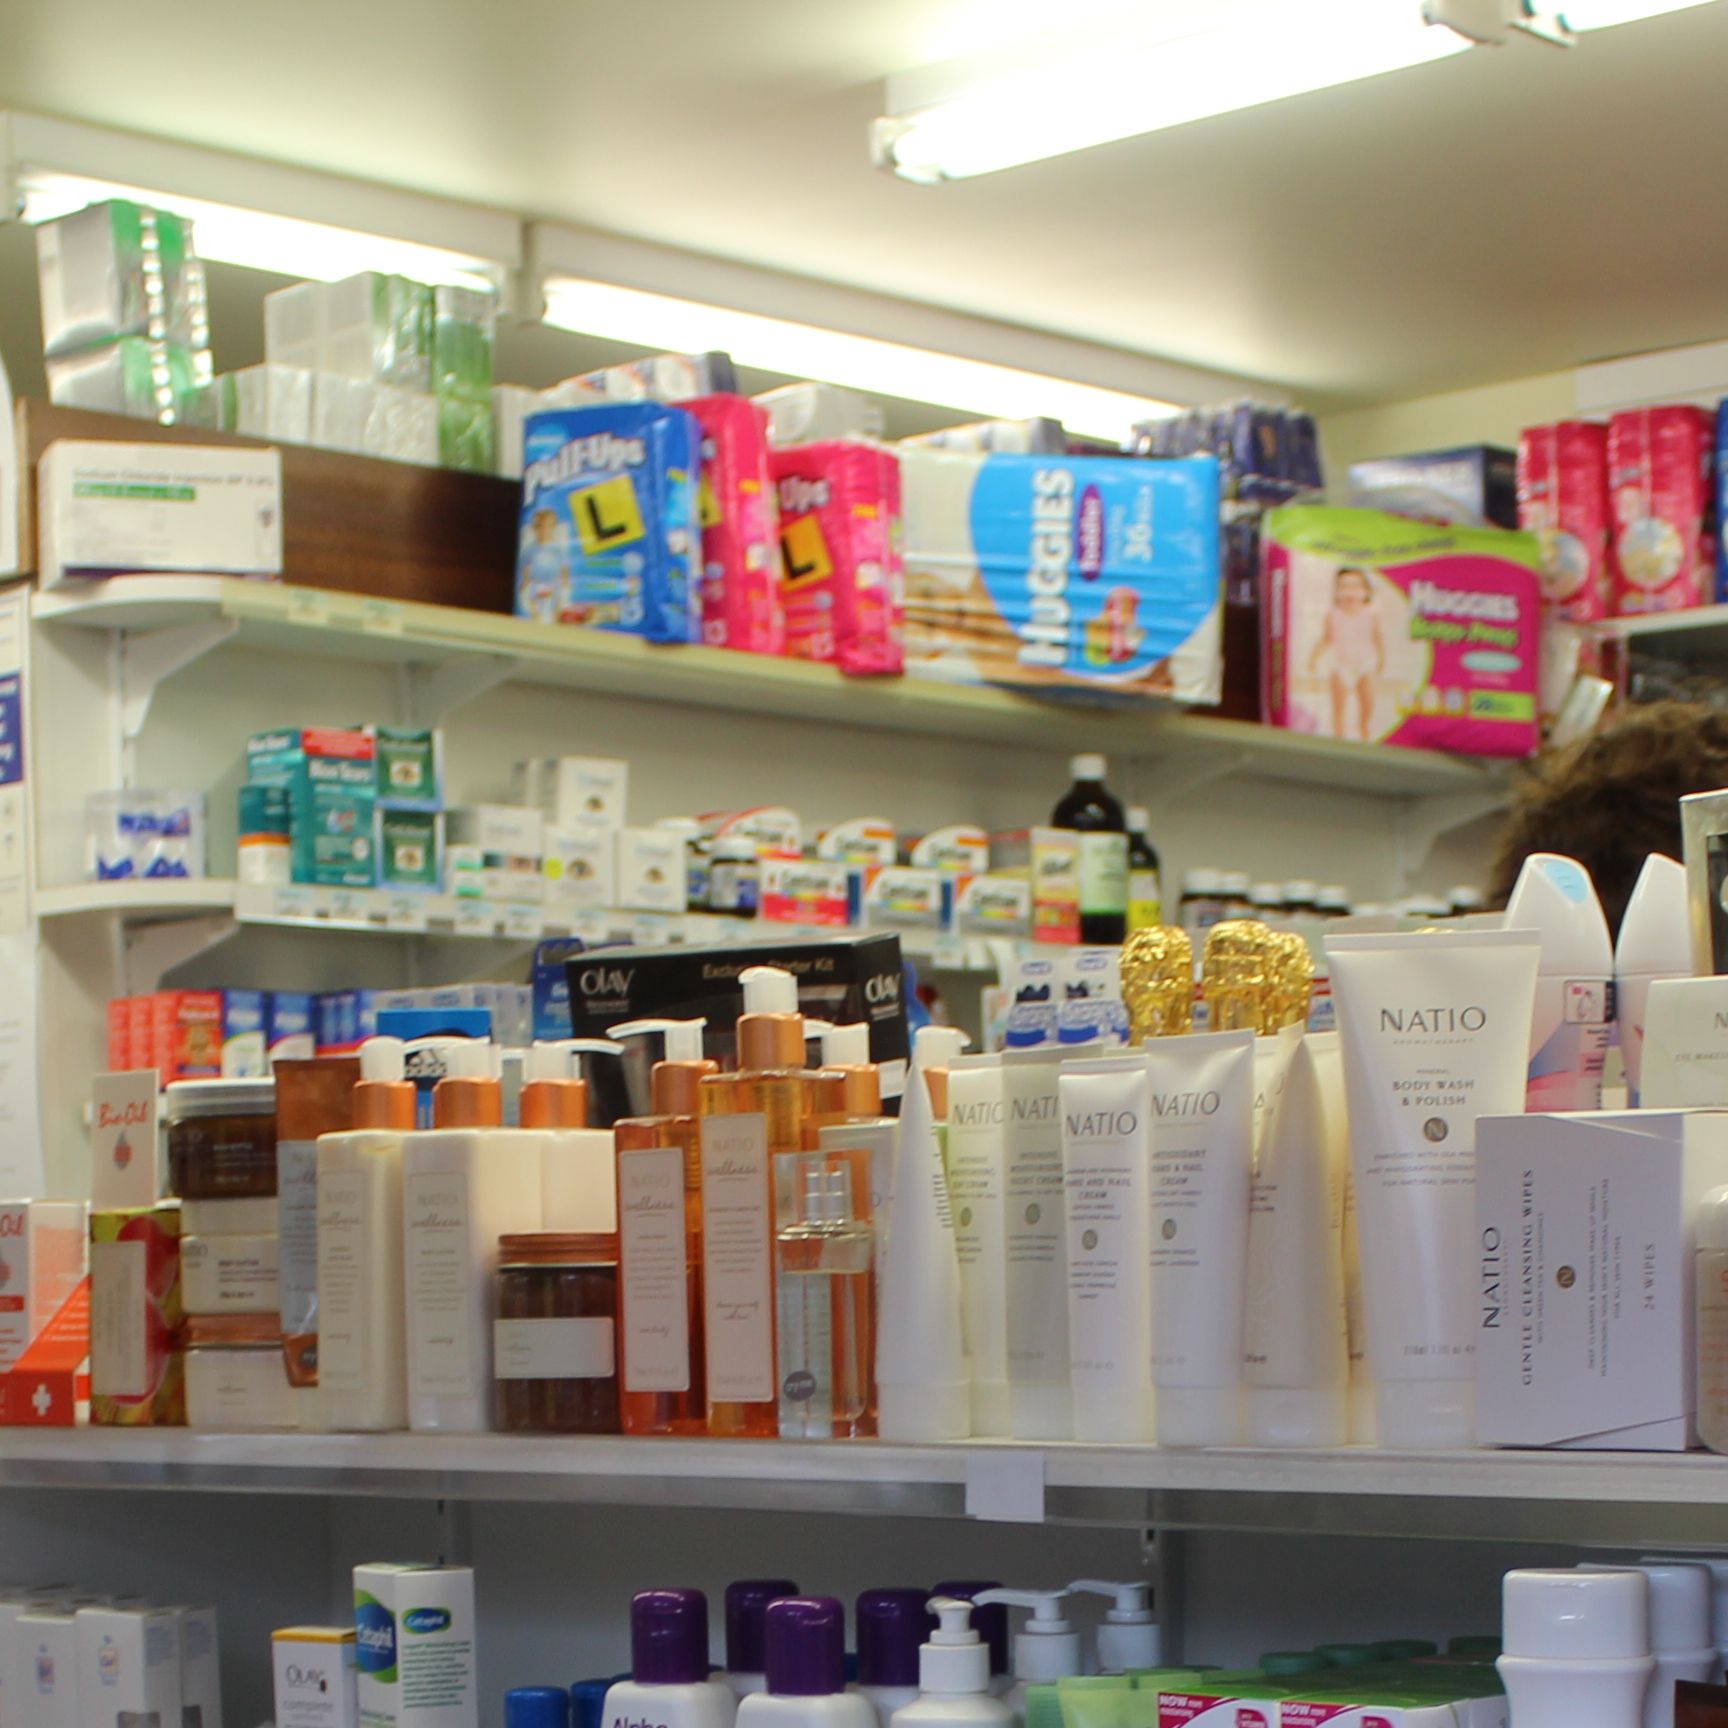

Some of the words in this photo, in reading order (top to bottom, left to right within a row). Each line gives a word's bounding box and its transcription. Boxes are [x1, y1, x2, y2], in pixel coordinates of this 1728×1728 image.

[586, 495, 627, 541] L
[781, 535, 816, 581] L
[1016, 466, 1074, 669] HUGGIES
[1379, 1005, 1486, 1034] NATIO
[1149, 1090, 1221, 1118] NATIO
[1392, 1080, 1431, 1091] BODY
[1436, 1079, 1475, 1091] WASH
[1415, 1095, 1467, 1106] POLISH
[1064, 1110, 1138, 1137] NATIO
[1522, 1169, 1534, 1218] WIPES
[1481, 1226, 1502, 1329] NATIO
[1522, 1224, 1534, 1318] CLEANSING
[1522, 1328, 1534, 1386] GENTLE
